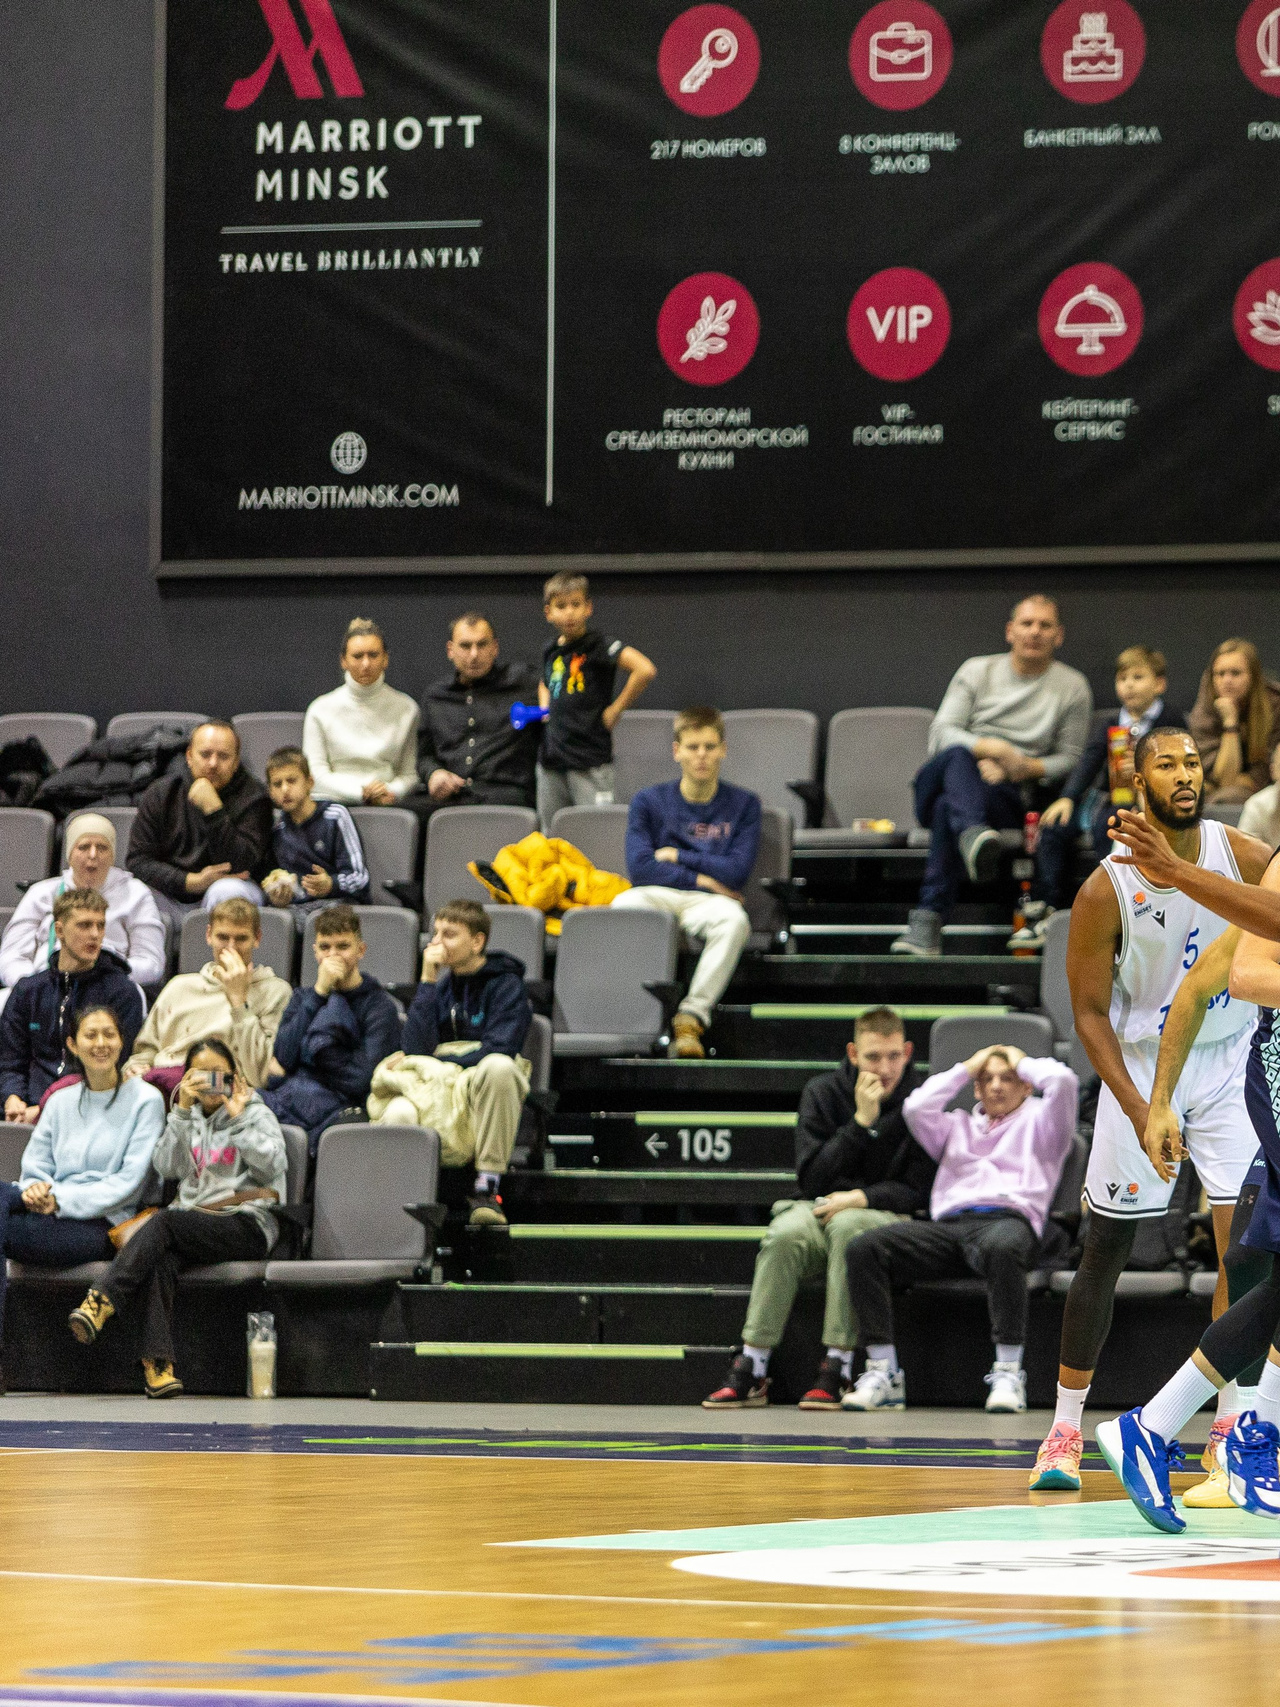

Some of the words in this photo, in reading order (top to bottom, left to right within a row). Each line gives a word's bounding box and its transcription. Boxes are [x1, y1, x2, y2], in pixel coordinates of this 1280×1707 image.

[255, 115, 483, 154] MARRIOTT
[1024, 123, 1124, 148] БАНКЕТНЫЙ
[650, 139, 680, 160] 217
[681, 137, 767, 159] НОМЕРОВ
[870, 154, 931, 175] ЗАЛОВ
[255, 165, 389, 202] MINSK
[218, 251, 308, 273] TRAVEL
[317, 246, 483, 272] BRILLIANTLY
[866, 304, 933, 343] VIP
[663, 407, 751, 428] РЕСТОРАН
[1054, 420, 1126, 441] СЕРВИС
[605, 424, 809, 451] СРЕДИЗЕМНОМОРСКОЙ
[852, 424, 944, 446] ГОСТИНАЯ
[678, 450, 735, 471] КУХНИ
[238, 483, 460, 510] MARRIOTTMINSK.COM
[1183, 927, 1200, 970] 5
[677, 1128, 732, 1162] 105
